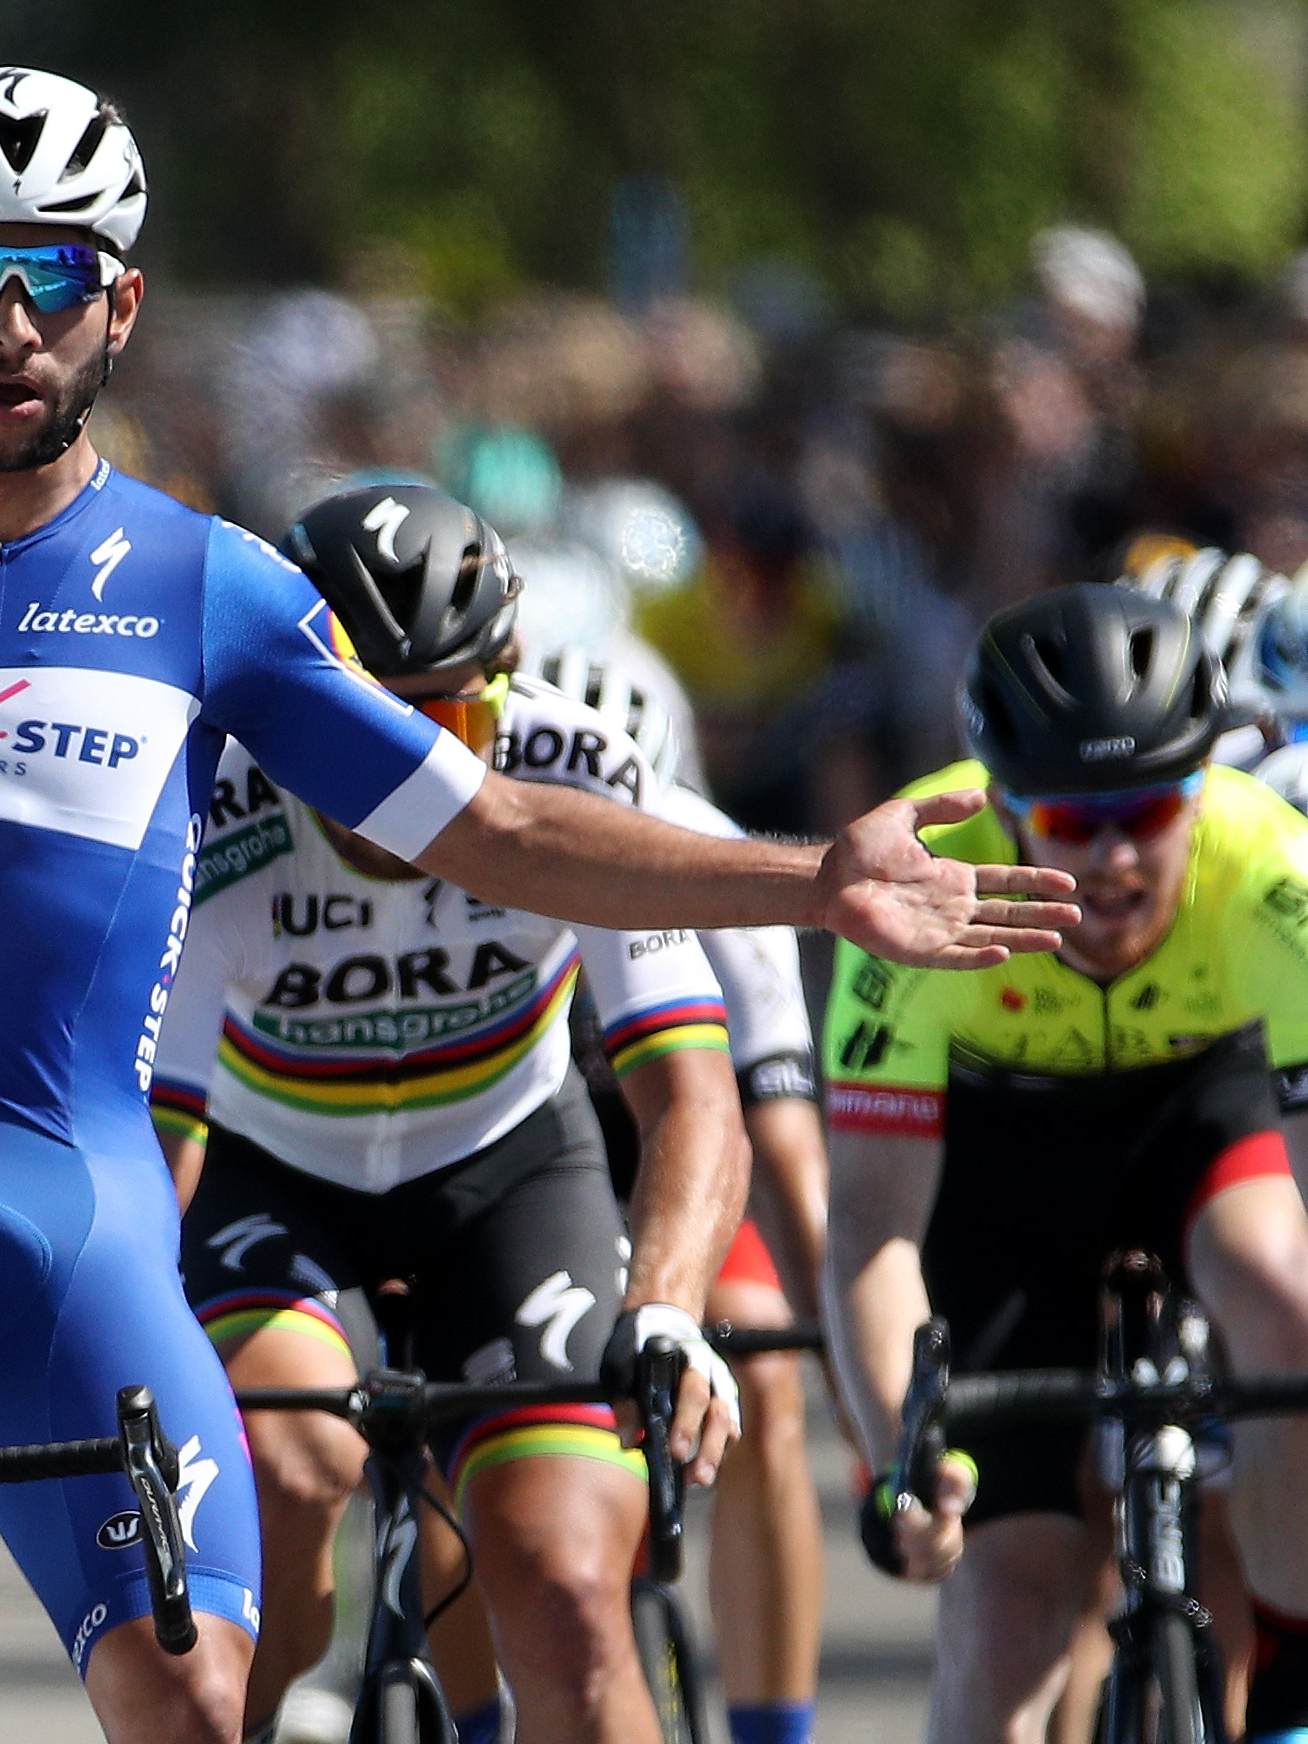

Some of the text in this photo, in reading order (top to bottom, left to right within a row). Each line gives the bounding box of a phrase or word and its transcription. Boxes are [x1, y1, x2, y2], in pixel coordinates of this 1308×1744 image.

[17, 602, 160, 638] latexco
[209, 766, 281, 827] RA
[493, 727, 640, 808] BORA
[280, 893, 373, 936] UCI
[262, 941, 533, 1007] BORA
